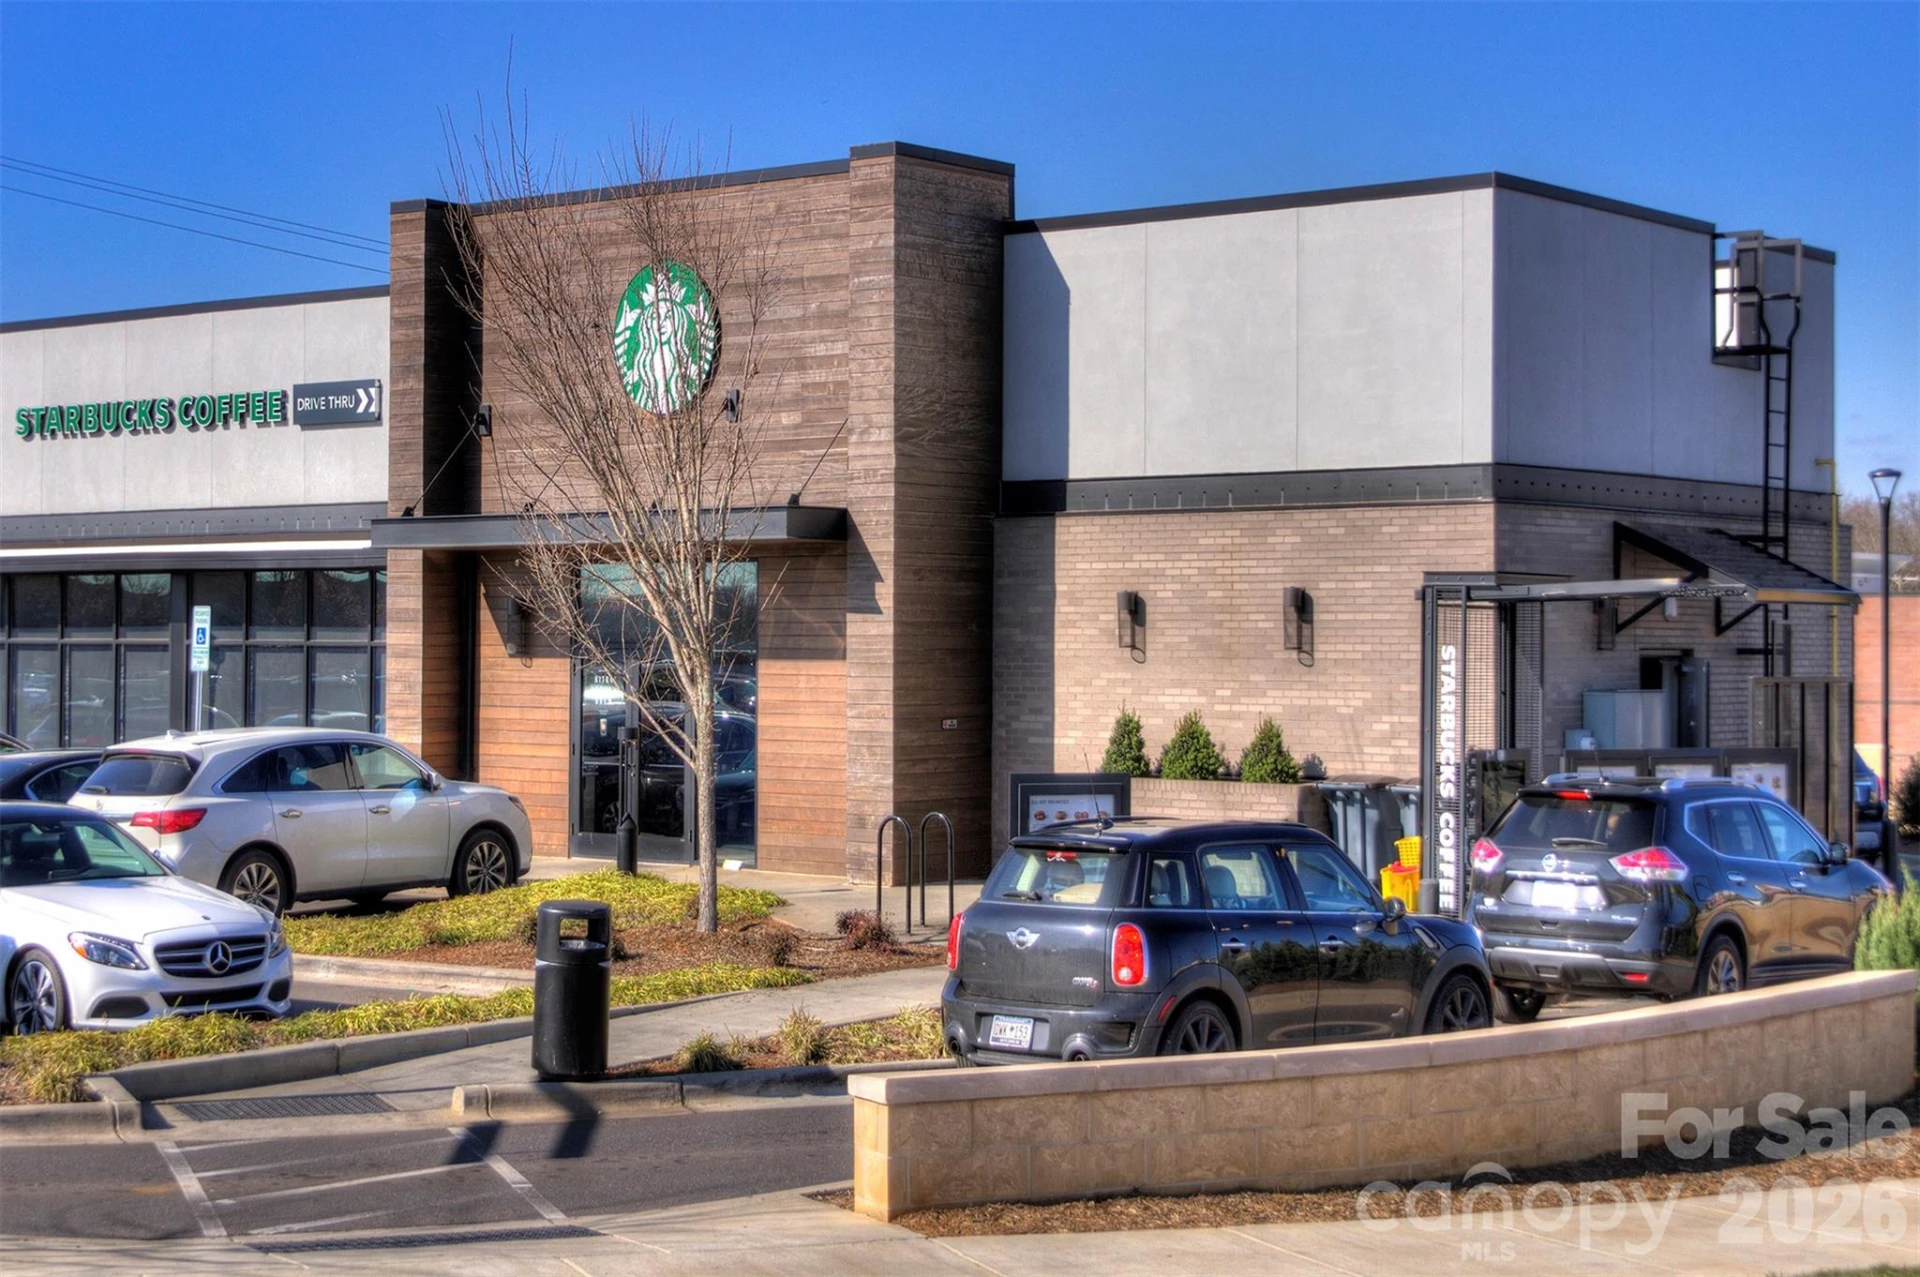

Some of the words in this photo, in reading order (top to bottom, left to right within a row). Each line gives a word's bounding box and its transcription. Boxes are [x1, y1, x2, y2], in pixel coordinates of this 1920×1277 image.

[15, 397, 170, 437] STARBUCKS
[178, 389, 283, 429] COFFEE
[297, 396, 327, 412] DRIVE
[328, 393, 356, 410] THRU
[1439, 644, 1456, 800] STARBUCKS
[1438, 812, 1455, 910] COFFEE
